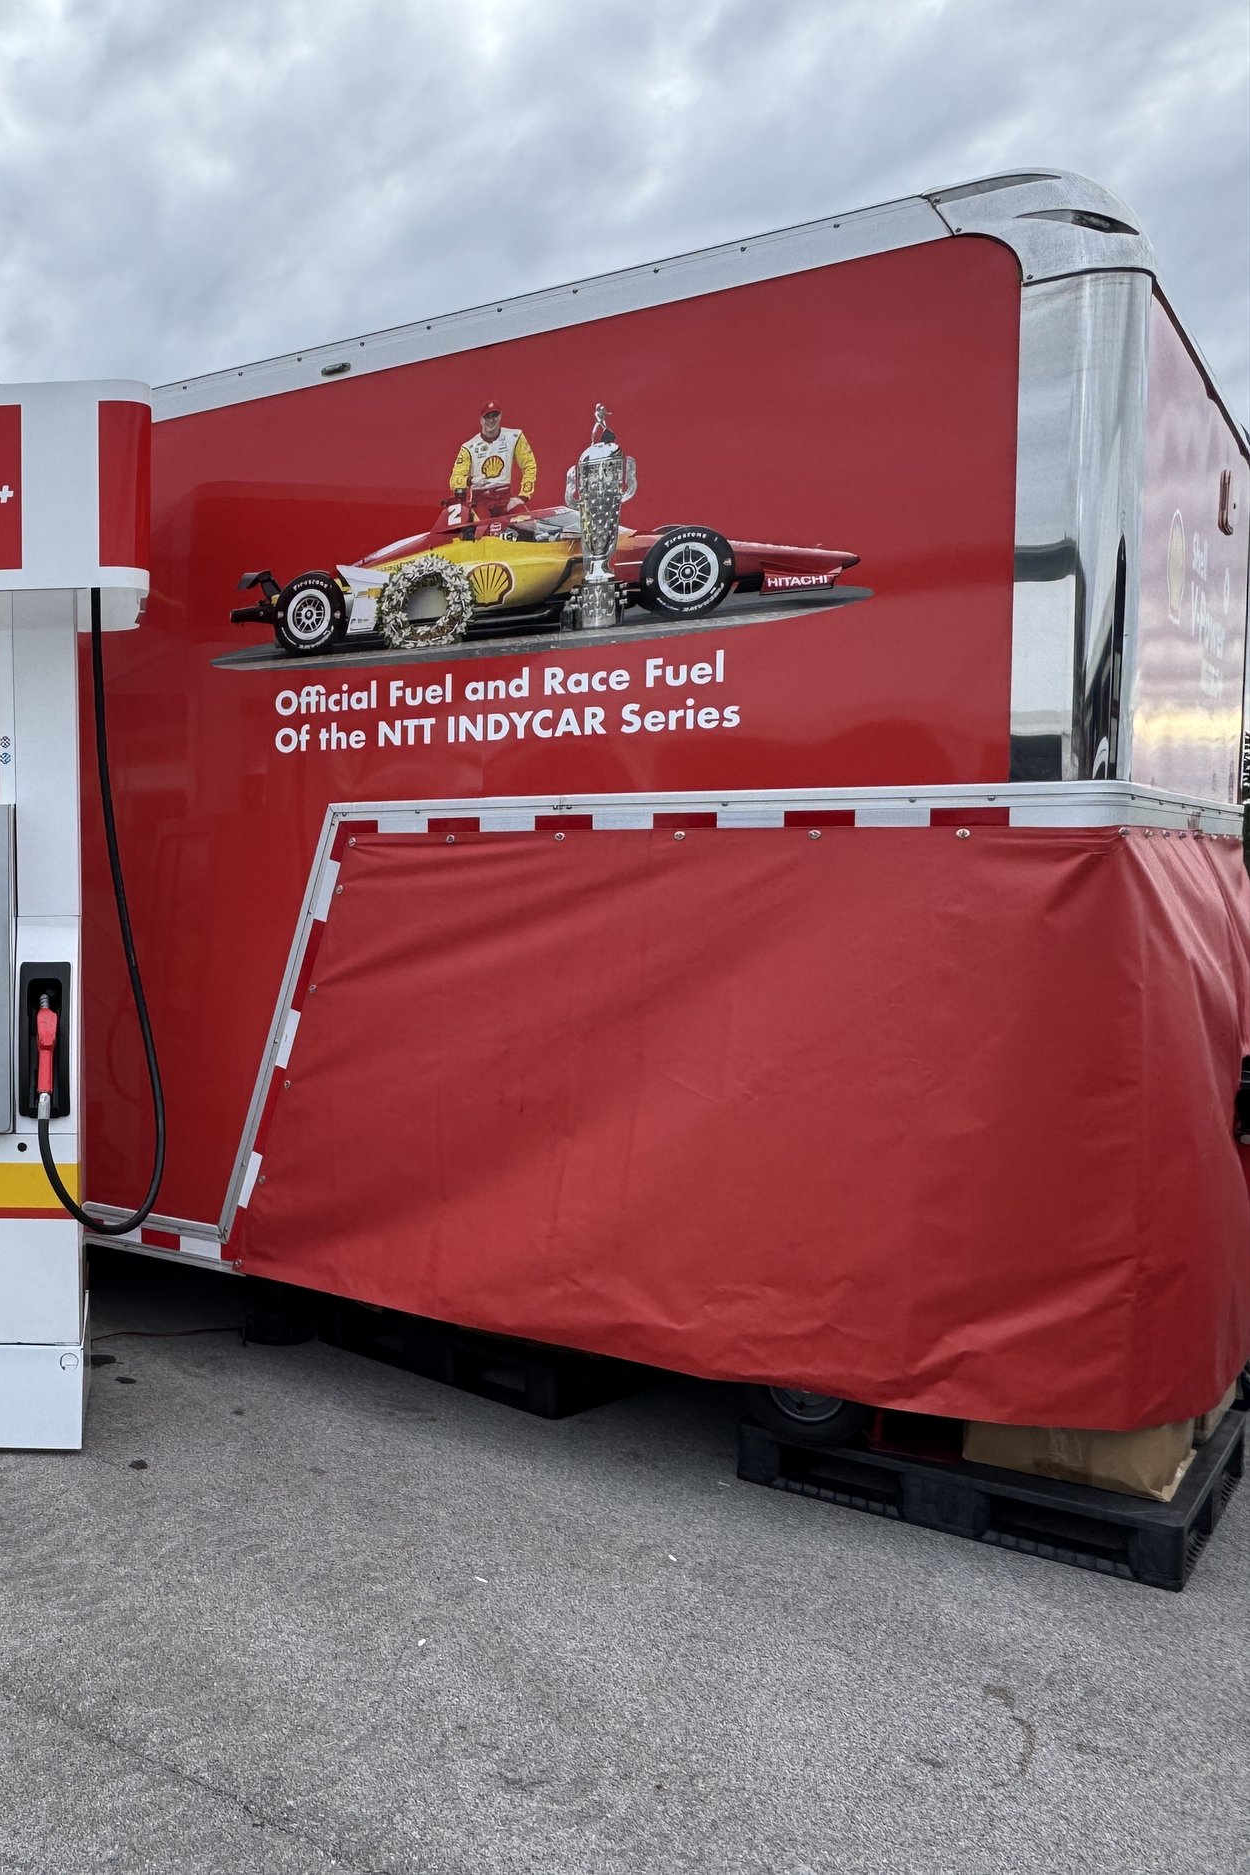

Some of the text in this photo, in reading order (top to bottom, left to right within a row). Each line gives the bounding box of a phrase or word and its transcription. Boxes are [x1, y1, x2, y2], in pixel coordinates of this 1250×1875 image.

[767, 574, 828, 587] HITACHI
[275, 649, 725, 717] Official Fuel and Race Fuel
[275, 698, 741, 753] Of the NTT INDYCAR Series
